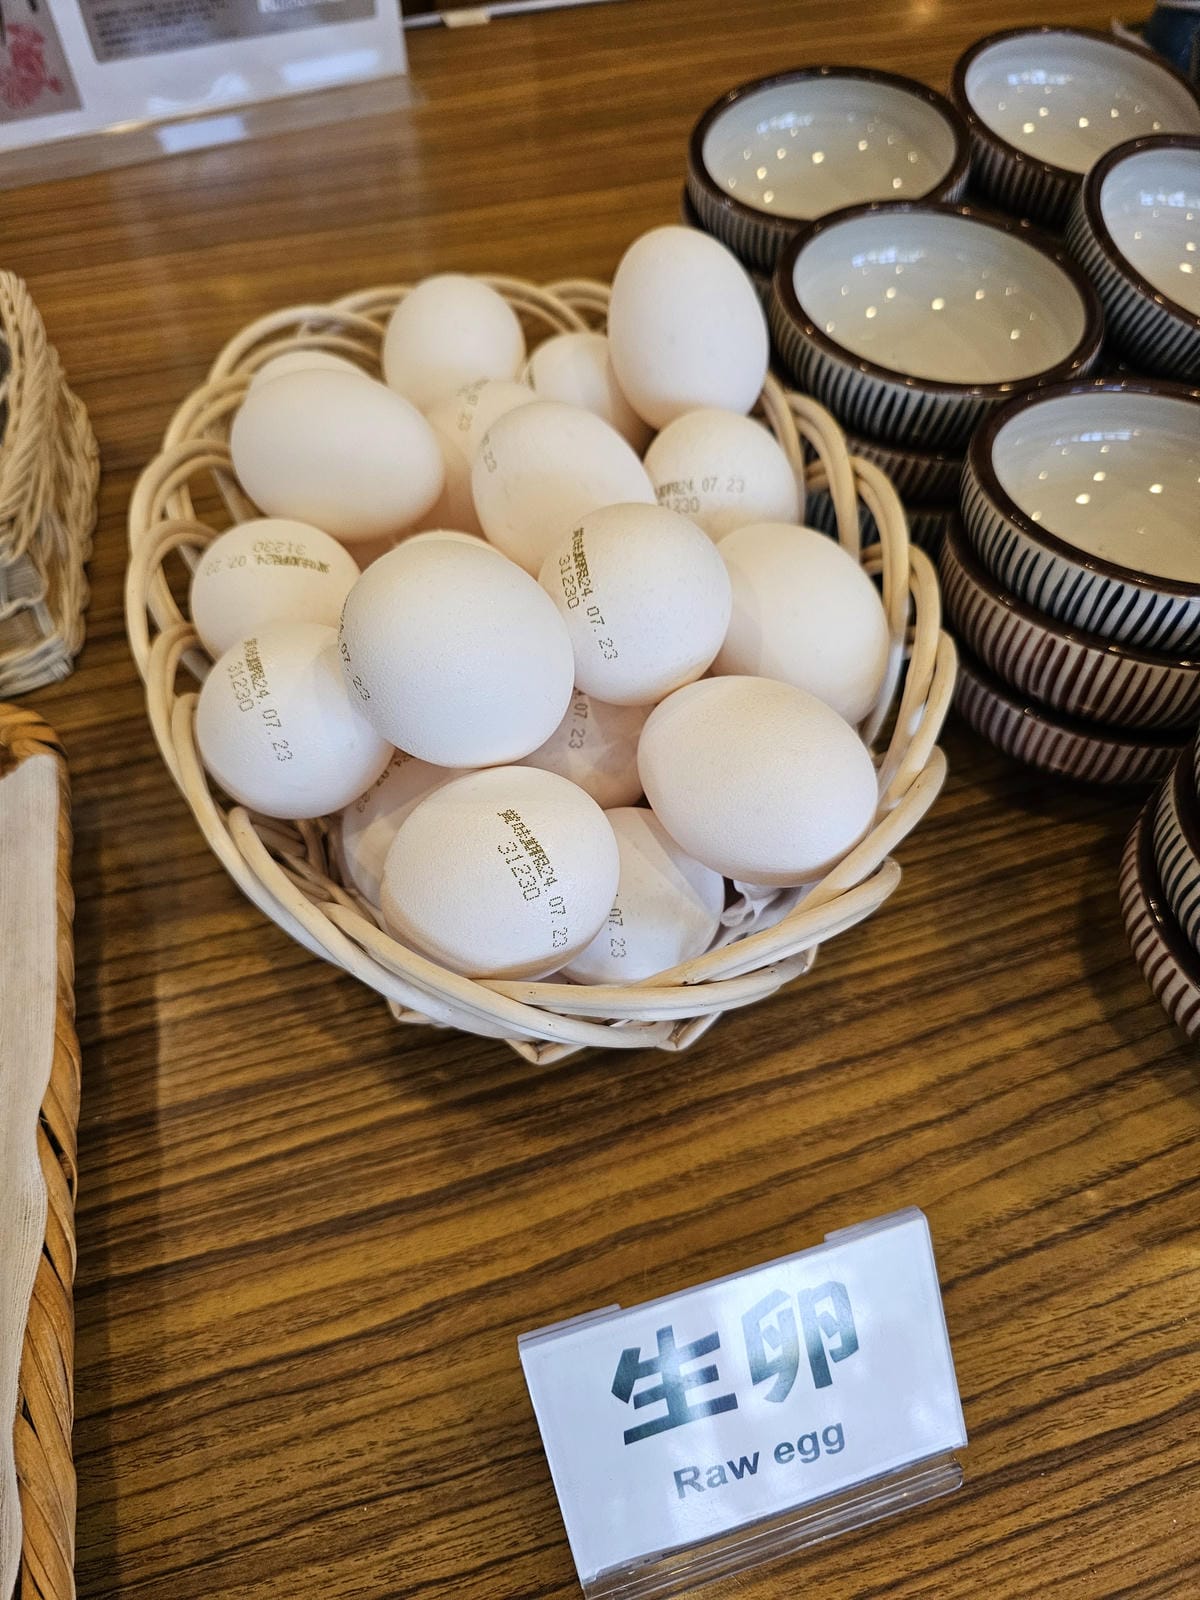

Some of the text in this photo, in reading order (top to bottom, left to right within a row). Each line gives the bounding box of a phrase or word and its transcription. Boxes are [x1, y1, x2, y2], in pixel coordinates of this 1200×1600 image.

[558, 556, 580, 610] 31230
[227, 662, 255, 713] 31230
[496, 840, 541, 902] 31230
[610, 1279, 860, 1446] 生卵
[672, 1420, 847, 1499] Raw egg
